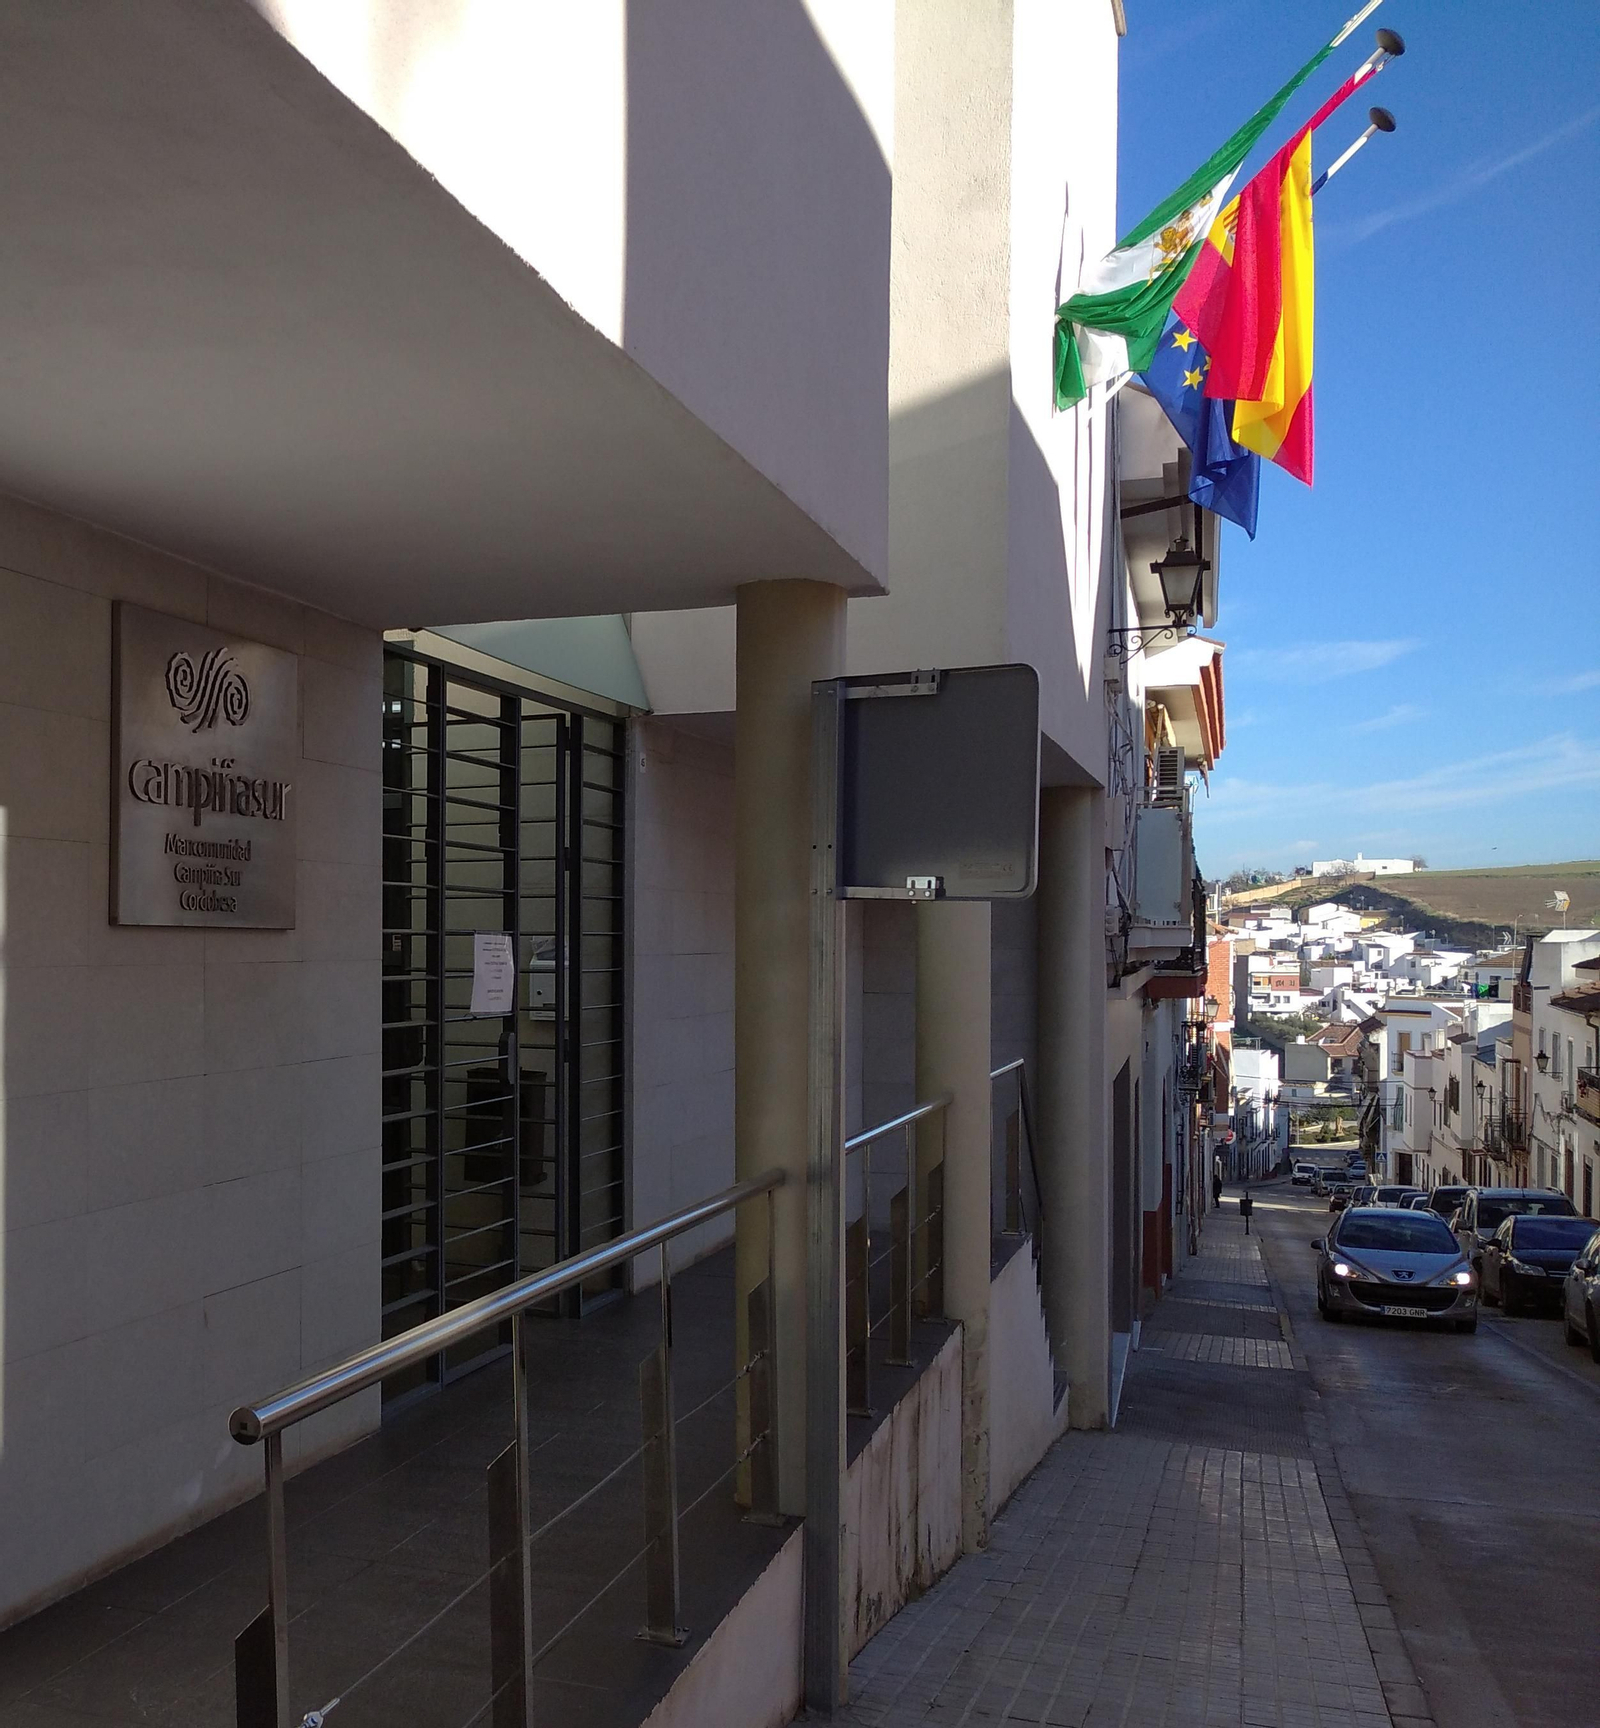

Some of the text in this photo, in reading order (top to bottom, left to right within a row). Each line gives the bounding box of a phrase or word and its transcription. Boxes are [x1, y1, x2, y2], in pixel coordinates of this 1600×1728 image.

[173, 862, 242, 890] Campiña Sur
[179, 890, 238, 913] Cordobesa
[1386, 1307, 1407, 1315] 7203
